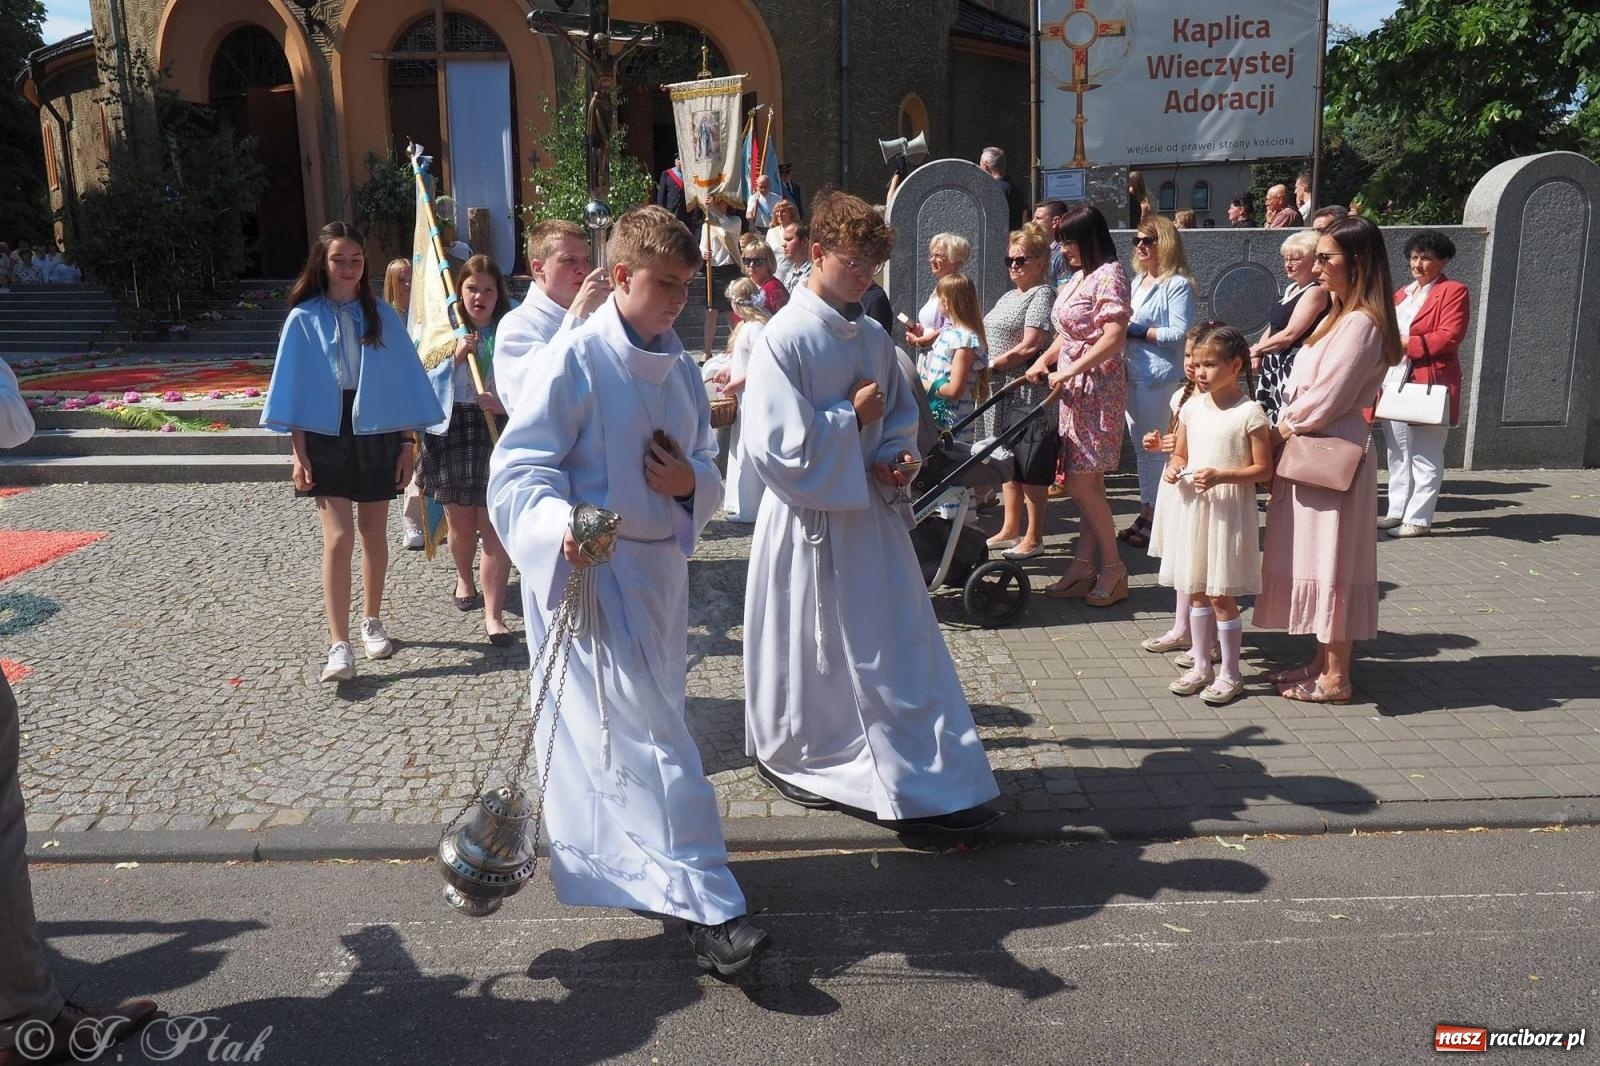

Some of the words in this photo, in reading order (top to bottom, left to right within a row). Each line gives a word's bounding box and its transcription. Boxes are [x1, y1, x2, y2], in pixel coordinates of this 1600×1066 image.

[1173, 15, 1270, 47] Kaplica
[1147, 48, 1294, 81] Wieczystej
[1164, 84, 1275, 116] Adoracji
[1127, 143, 1162, 155] wejście
[1166, 142, 1178, 152] od
[1181, 141, 1216, 154] prawej
[1219, 138, 1251, 150] strony
[1253, 136, 1295, 148] kościoła
